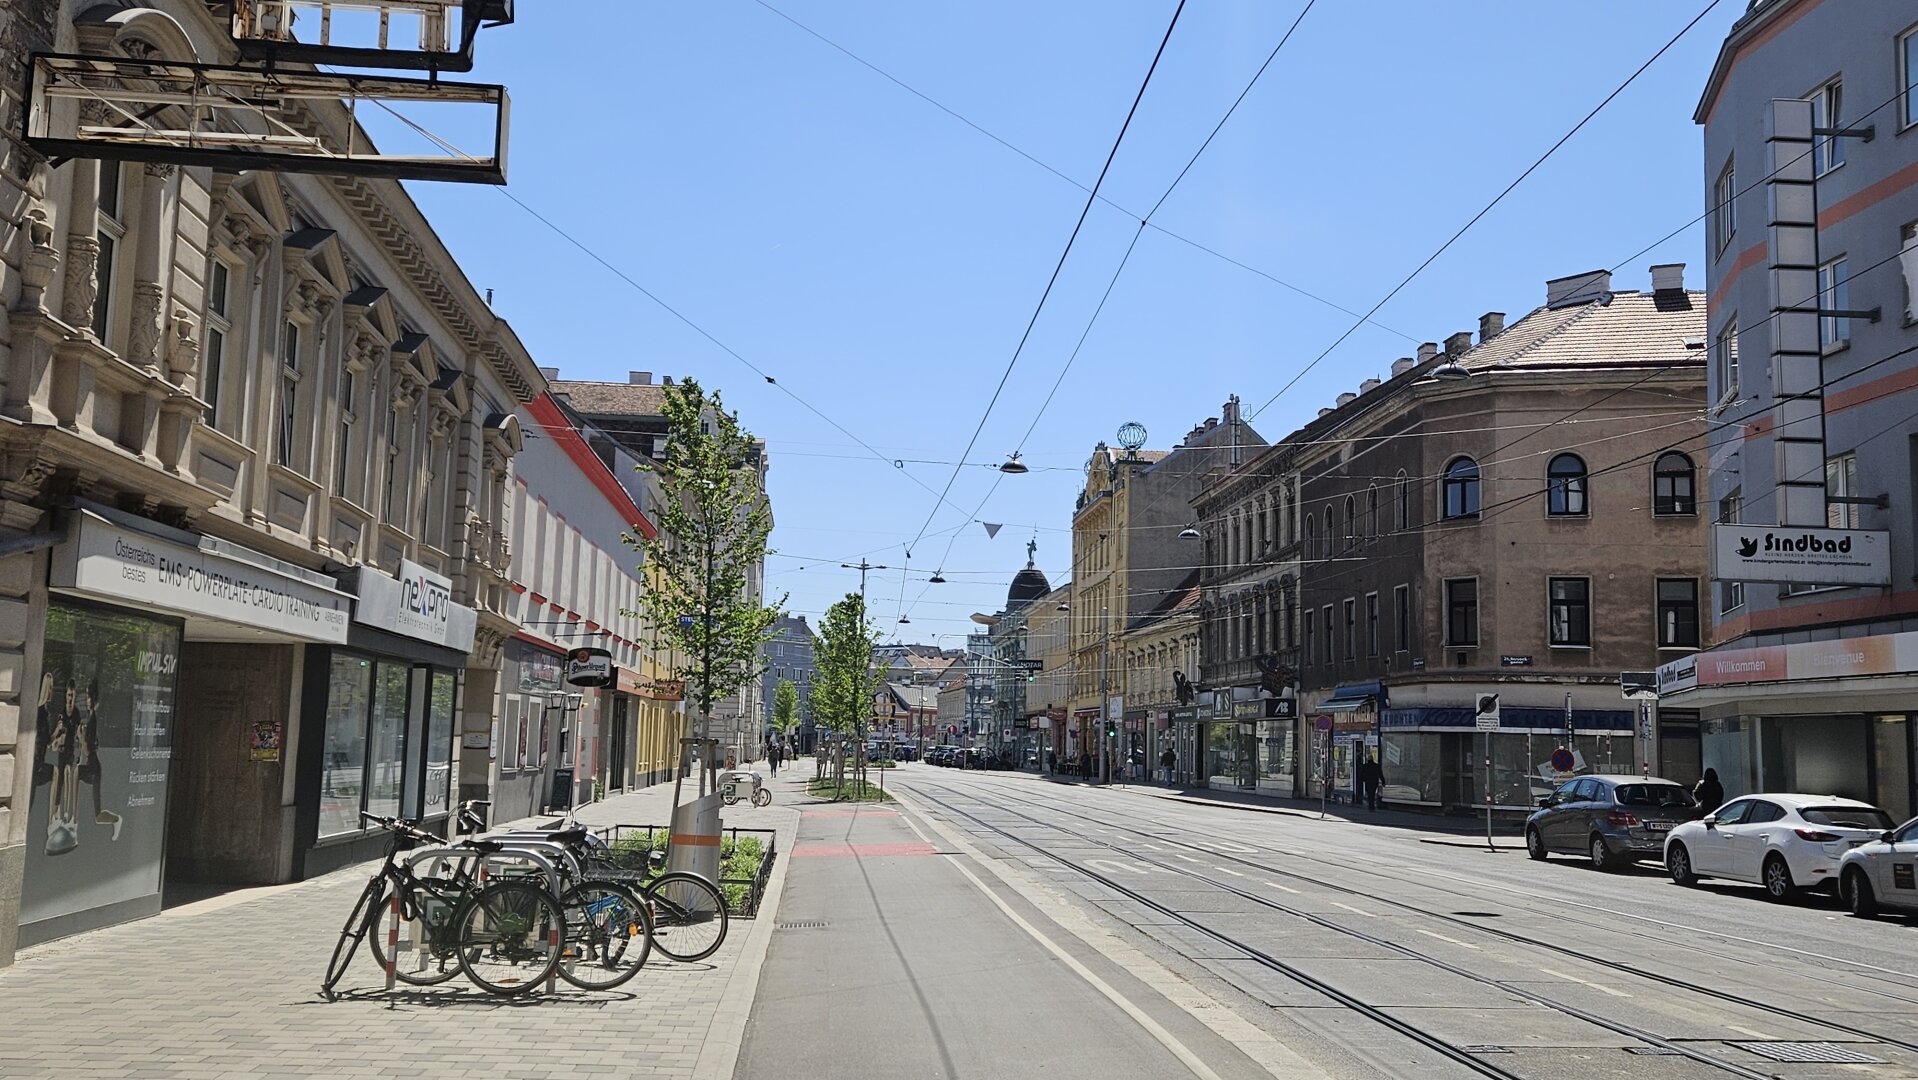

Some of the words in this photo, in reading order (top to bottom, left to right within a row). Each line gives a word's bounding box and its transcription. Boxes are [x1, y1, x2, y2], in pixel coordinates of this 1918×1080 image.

[115, 536, 155, 566] Österreichs
[1764, 533, 1851, 553] Sindbad
[122, 562, 146, 583] bestes
[286, 594, 319, 622] TRAINING
[1716, 660, 1766, 674] Willkommen
